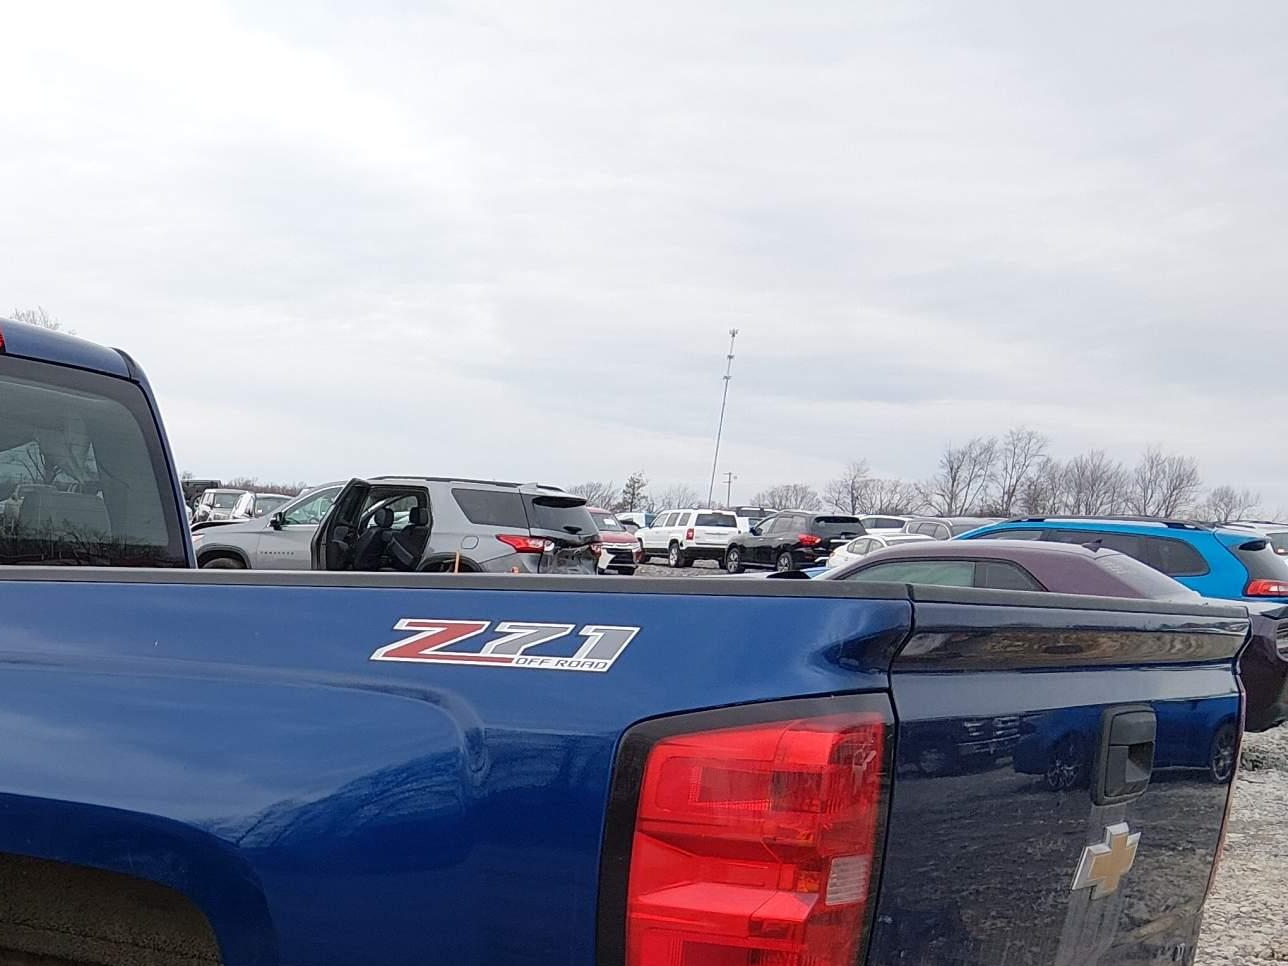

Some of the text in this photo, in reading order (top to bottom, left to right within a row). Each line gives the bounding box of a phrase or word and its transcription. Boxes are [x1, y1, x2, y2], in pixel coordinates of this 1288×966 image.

[370, 618, 641, 672] Z71
[515, 657, 609, 669] OFF ROAD
